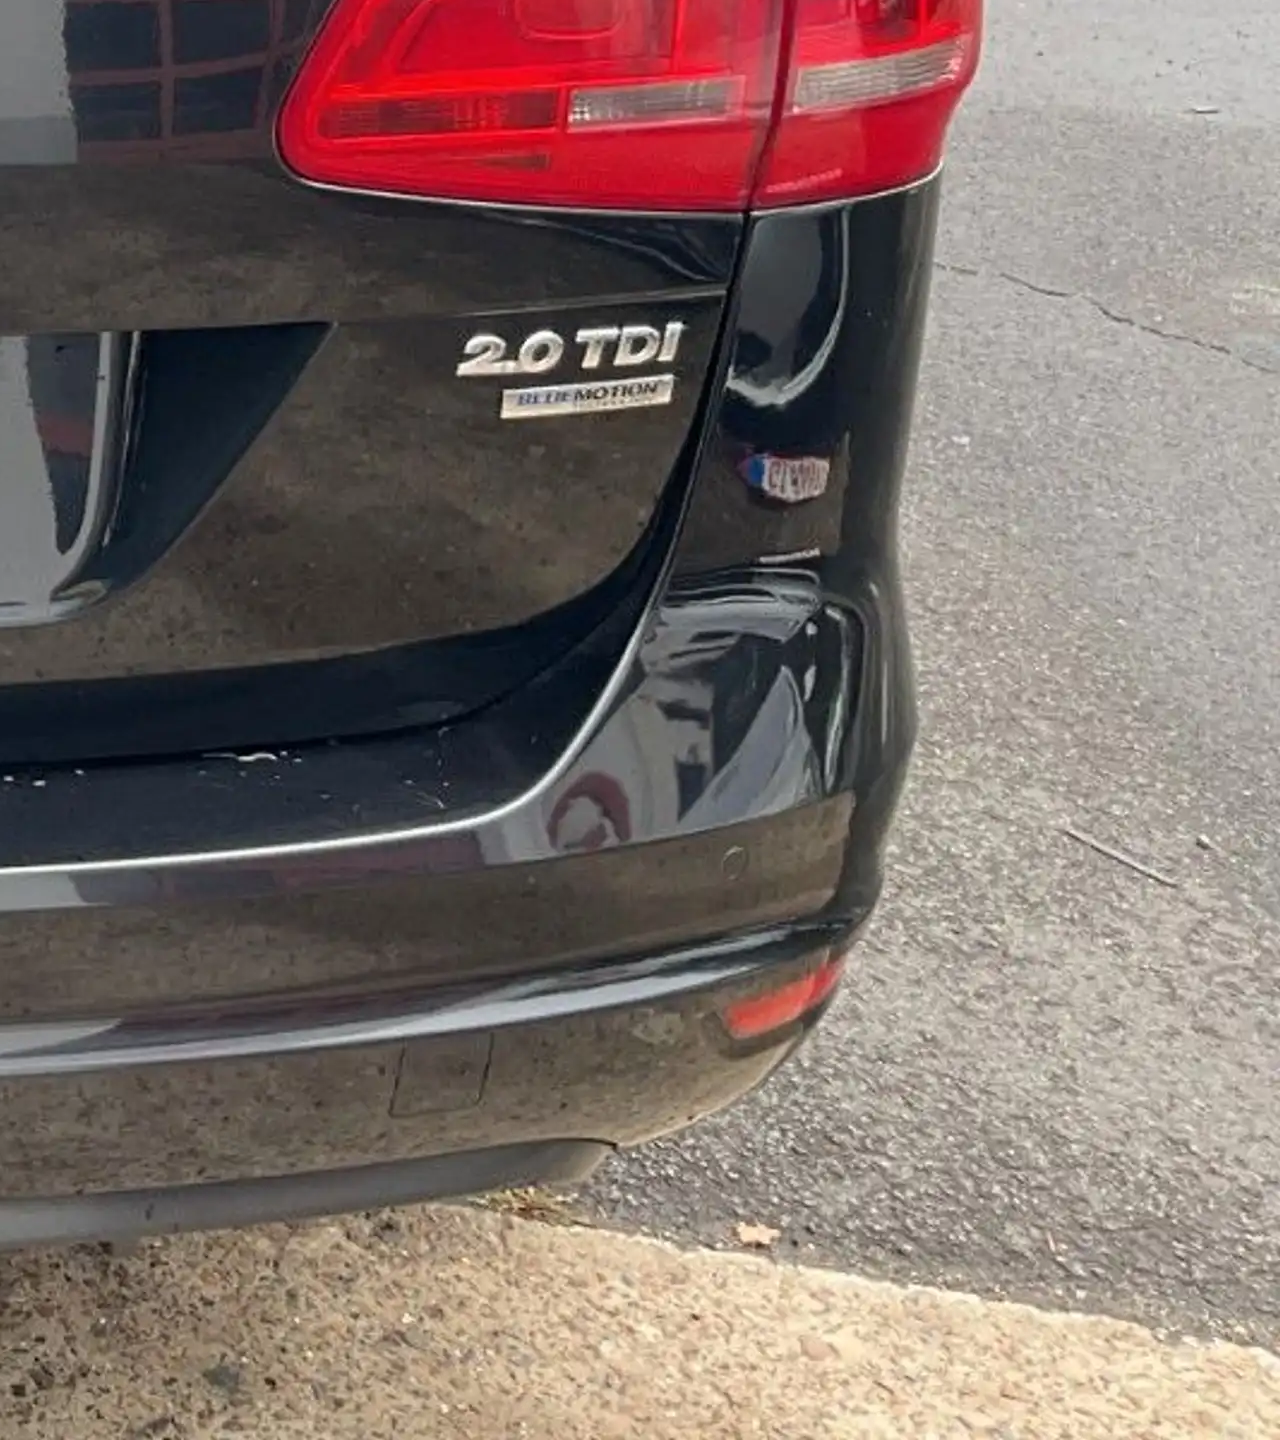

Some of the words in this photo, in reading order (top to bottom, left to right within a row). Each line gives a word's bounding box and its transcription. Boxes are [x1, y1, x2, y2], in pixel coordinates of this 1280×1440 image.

[456, 329, 565, 378] 2.0
[574, 321, 687, 369] TDI
[516, 381, 660, 407] BLUEMOTION
